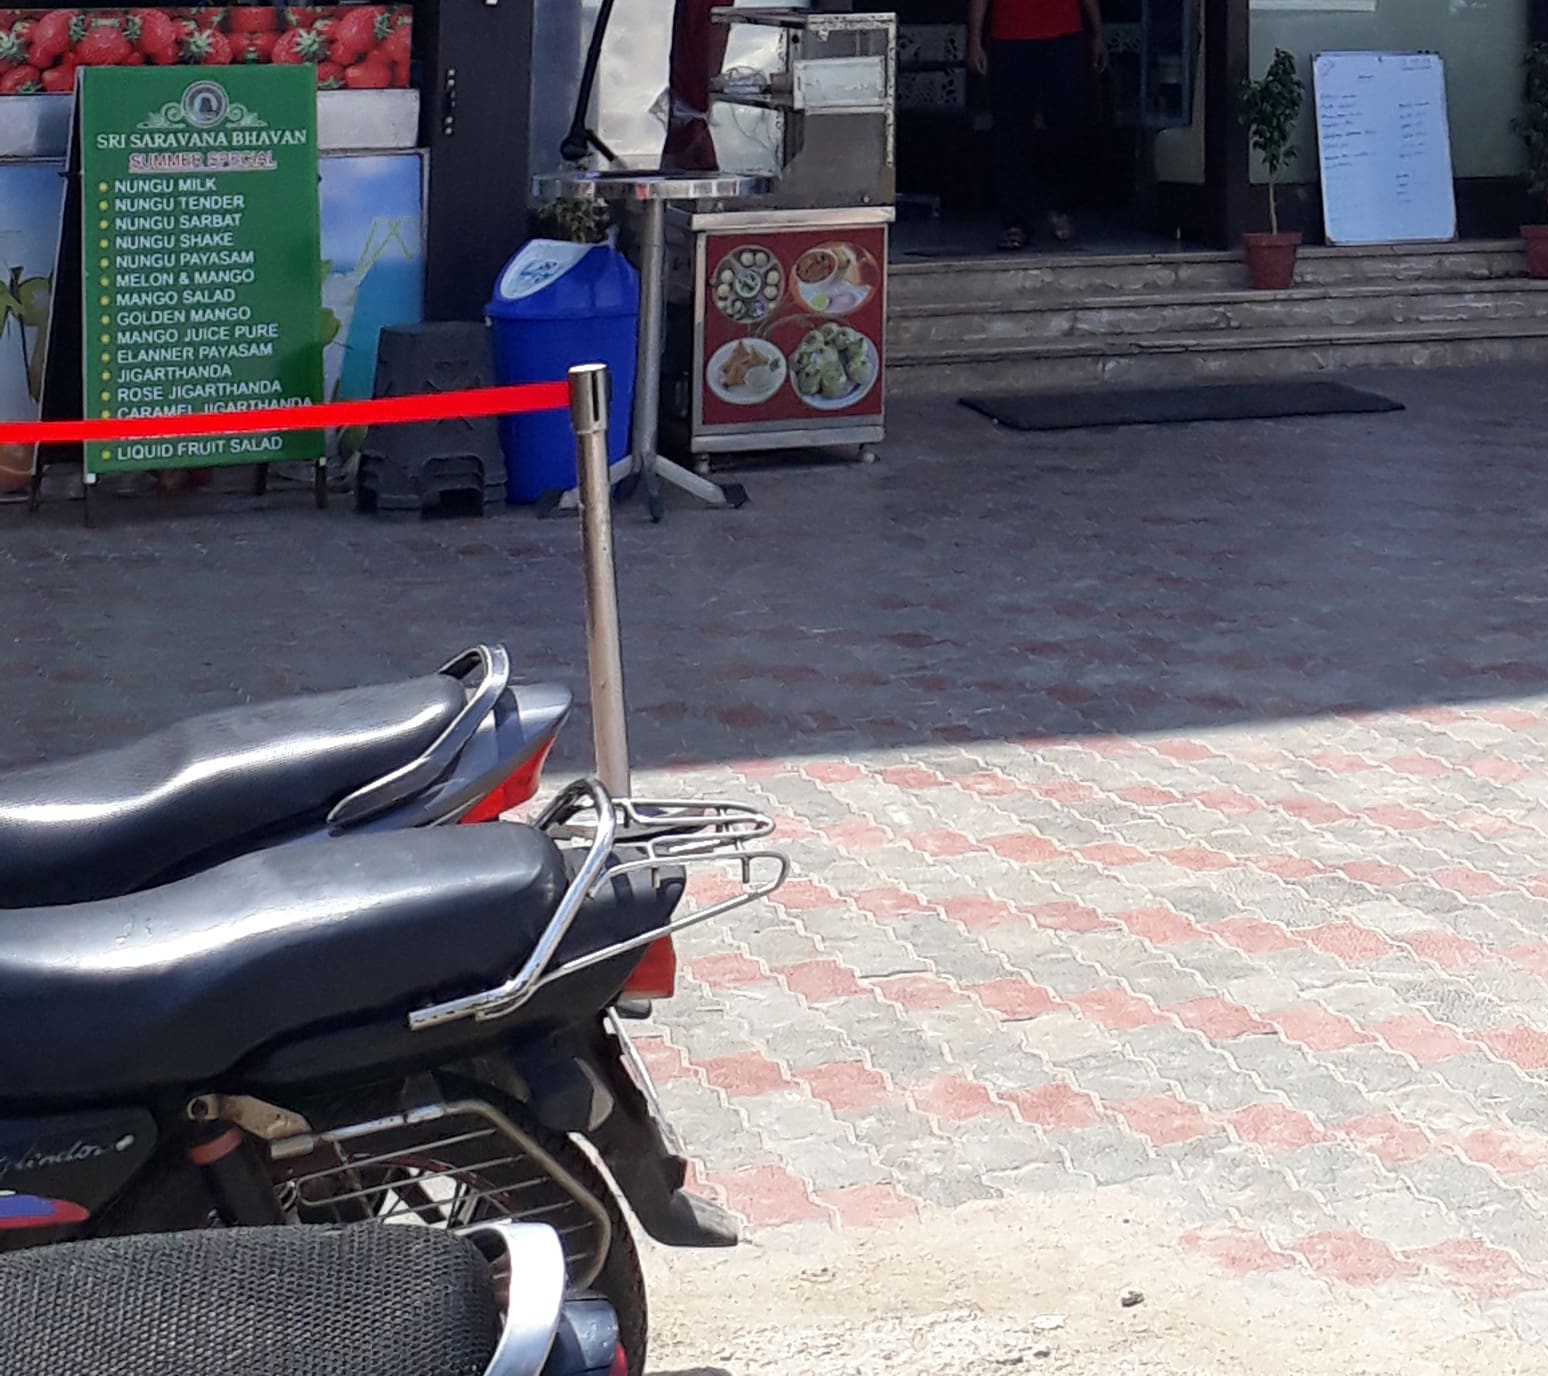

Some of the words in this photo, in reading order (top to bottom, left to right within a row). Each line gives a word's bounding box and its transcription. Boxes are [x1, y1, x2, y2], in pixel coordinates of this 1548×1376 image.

[96, 134, 126, 149] SRI
[130, 131, 228, 148] SARAVANA
[232, 130, 307, 146] BHAVAN
[129, 152, 202, 169] SUMMER
[206, 150, 276, 169] SPECIAL
[114, 179, 174, 193] NUNGU
[178, 177, 216, 191] MILK
[115, 197, 174, 212] NUNGU
[179, 195, 245, 210] TENDER
[115, 216, 175, 231] NUNGU
[179, 213, 242, 228] SARBAT
[115, 235, 175, 250] NUNGU
[180, 232, 234, 248] SHAKE
[116, 253, 176, 269] NUNGU
[180, 251, 254, 266] PAYASAM
[116, 272, 174, 287] MELON
[178, 272, 190, 285] &
[194, 269, 255, 284] MANGO
[116, 291, 178, 306] MANGO
[182, 288, 236, 304] SALAD
[117, 309, 186, 326] GOLDEN
[190, 306, 251, 322] MANGO
[117, 329, 179, 345] MANGO
[183, 326, 231, 342] JUICE
[235, 323, 279, 339] PURE
[117, 347, 194, 364] ELANNER
[199, 343, 273, 360] PAYASAM
[117, 364, 232, 383] JIGARTHANDA
[117, 386, 164, 402] ROSE
[168, 380, 282, 399] JIGARTHANDA
[117, 443, 174, 461] LIQUID
[177, 439, 226, 456] FRUIT
[230, 436, 283, 453] SALAD
